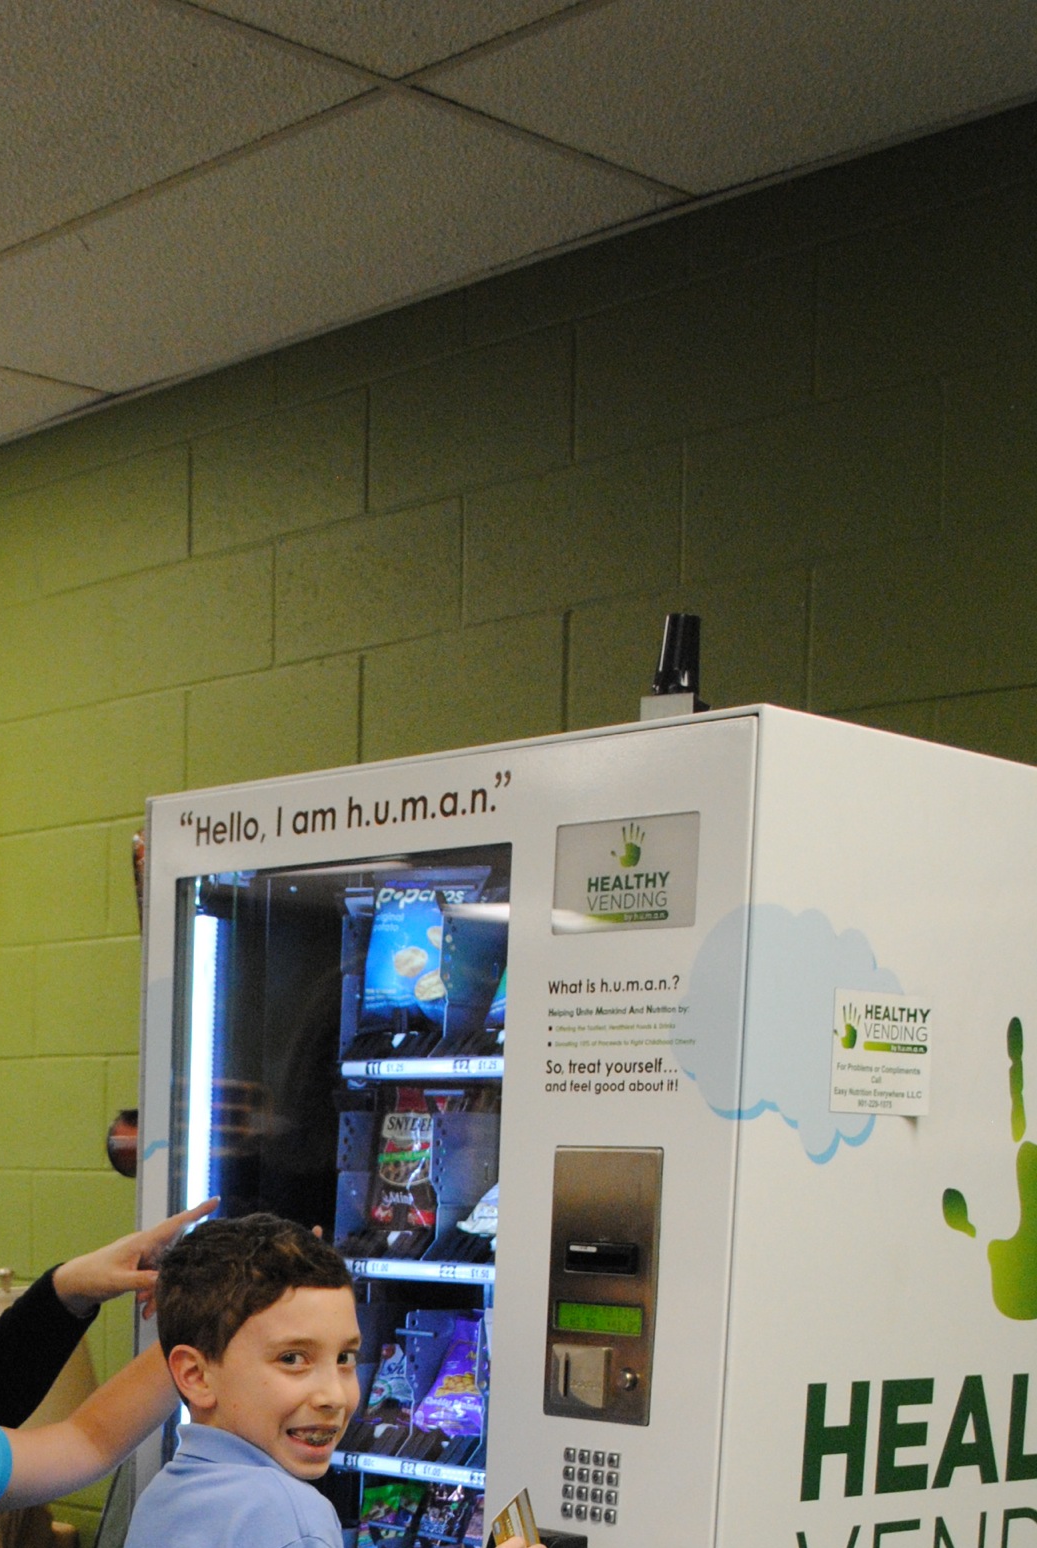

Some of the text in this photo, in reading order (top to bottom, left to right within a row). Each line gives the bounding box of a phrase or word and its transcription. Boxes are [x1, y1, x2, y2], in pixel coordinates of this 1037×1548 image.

[180, 811, 266, 846] “Hello,
[276, 806, 283, 837] I
[292, 806, 336, 834] am
[586, 871, 670, 893] HEALTHY
[586, 890, 668, 912] VENDING
[548, 975, 680, 994] What is h.u.m.a.n.?
[548, 1008, 574, 1018] Helping
[576, 1007, 593, 1016] Unite
[595, 1007, 626, 1016] Mankind
[629, 1006, 644, 1015] And
[646, 1004, 676, 1014] Nutrition
[864, 1004, 931, 1024] HEALTHY
[864, 1022, 928, 1042] VENDING
[546, 1060, 564, 1075] So,
[569, 1059, 601, 1074] treat
[545, 1079, 679, 1094] and feel good about it!
[800, 1373, 1037, 1502] HEAL
[346, 1455, 357, 1467] 31
[402, 1462, 414, 1474] 32
